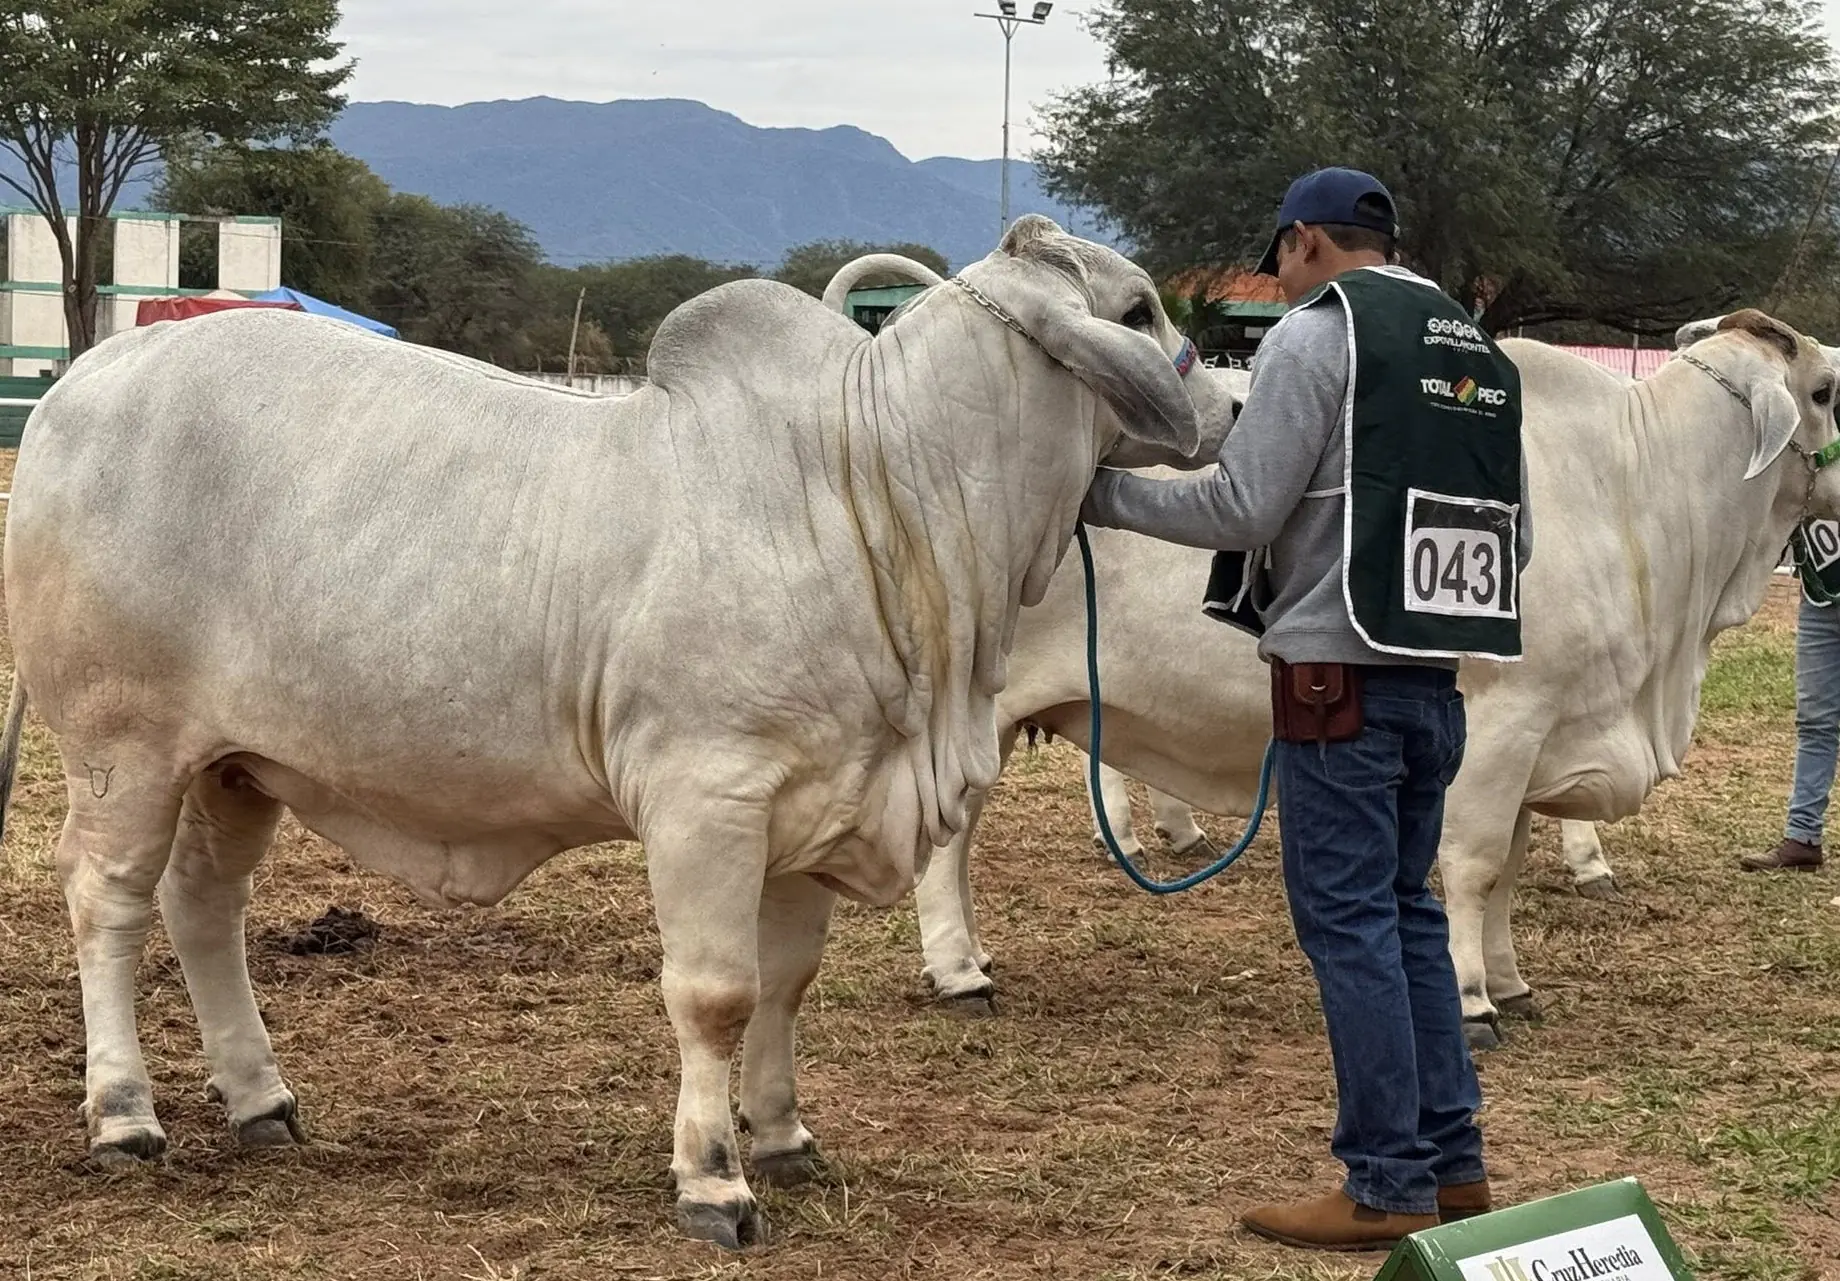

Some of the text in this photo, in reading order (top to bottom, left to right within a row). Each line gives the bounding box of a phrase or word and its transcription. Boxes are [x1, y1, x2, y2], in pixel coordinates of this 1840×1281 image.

[1420, 379, 1507, 405] TOTAL PEC
[1413, 538, 1496, 605] 043
[1532, 1245, 1643, 1281] CruzHeredia
